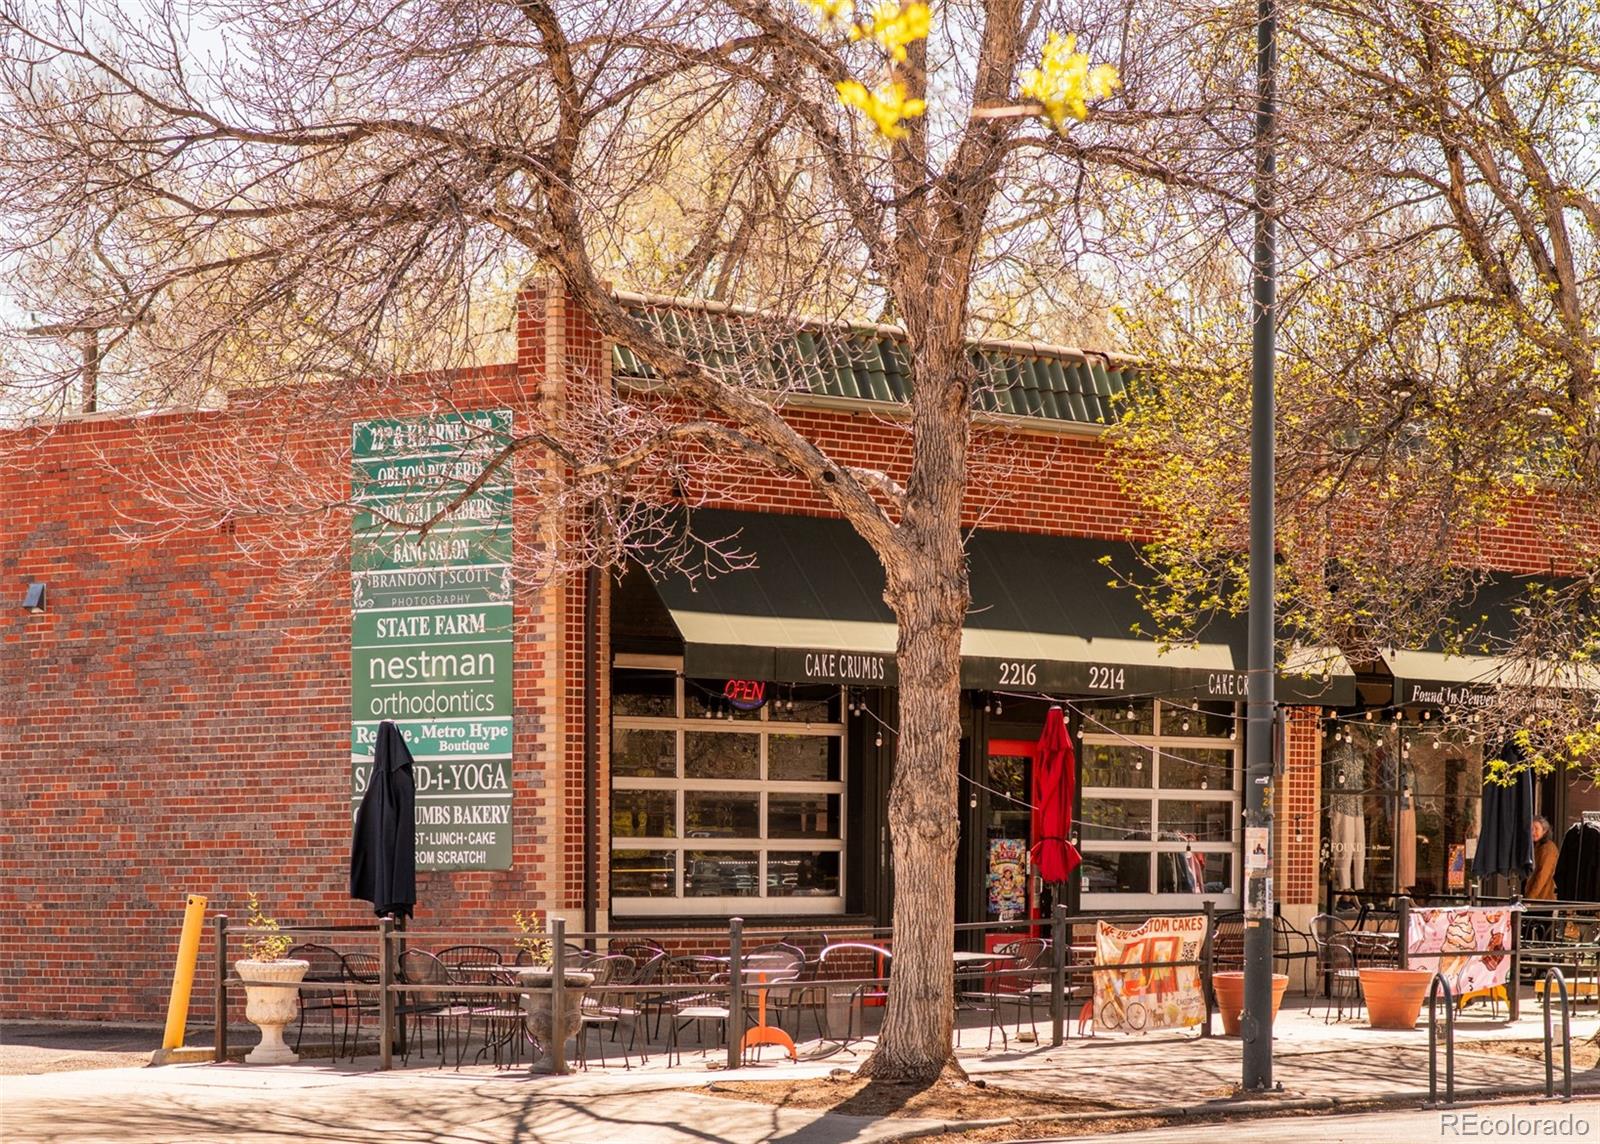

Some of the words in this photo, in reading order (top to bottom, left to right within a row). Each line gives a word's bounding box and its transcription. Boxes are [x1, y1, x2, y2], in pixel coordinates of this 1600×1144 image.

[393, 541, 427, 564] BANG
[430, 539, 471, 562] SALON
[372, 571, 437, 589] BRANDON
[439, 570, 448, 589] J.
[449, 568, 490, 584] SCOTT
[391, 593, 471, 607] PHOTOGRAPHY
[376, 616, 431, 638] STATE
[434, 613, 487, 635] FARM
[369, 651, 495, 680] nestman
[804, 653, 835, 677] CAKE
[839, 654, 885, 680] CRUMBS
[998, 662, 1037, 686] 2216
[1088, 666, 1126, 690] 2214
[1208, 673, 1234, 695] CAKE
[723, 679, 766, 701] OPEN
[1412, 684, 1445, 706] Found
[370, 689, 495, 715] orthodontics
[421, 724, 466, 739] Metro
[469, 722, 509, 740] Hype
[438, 740, 490, 753] Boutique
[452, 804, 511, 825] BAKERY
[414, 851, 435, 864] ROM
[437, 850, 487, 864] SCRATCH!
[1172, 917, 1203, 931] CAKES
